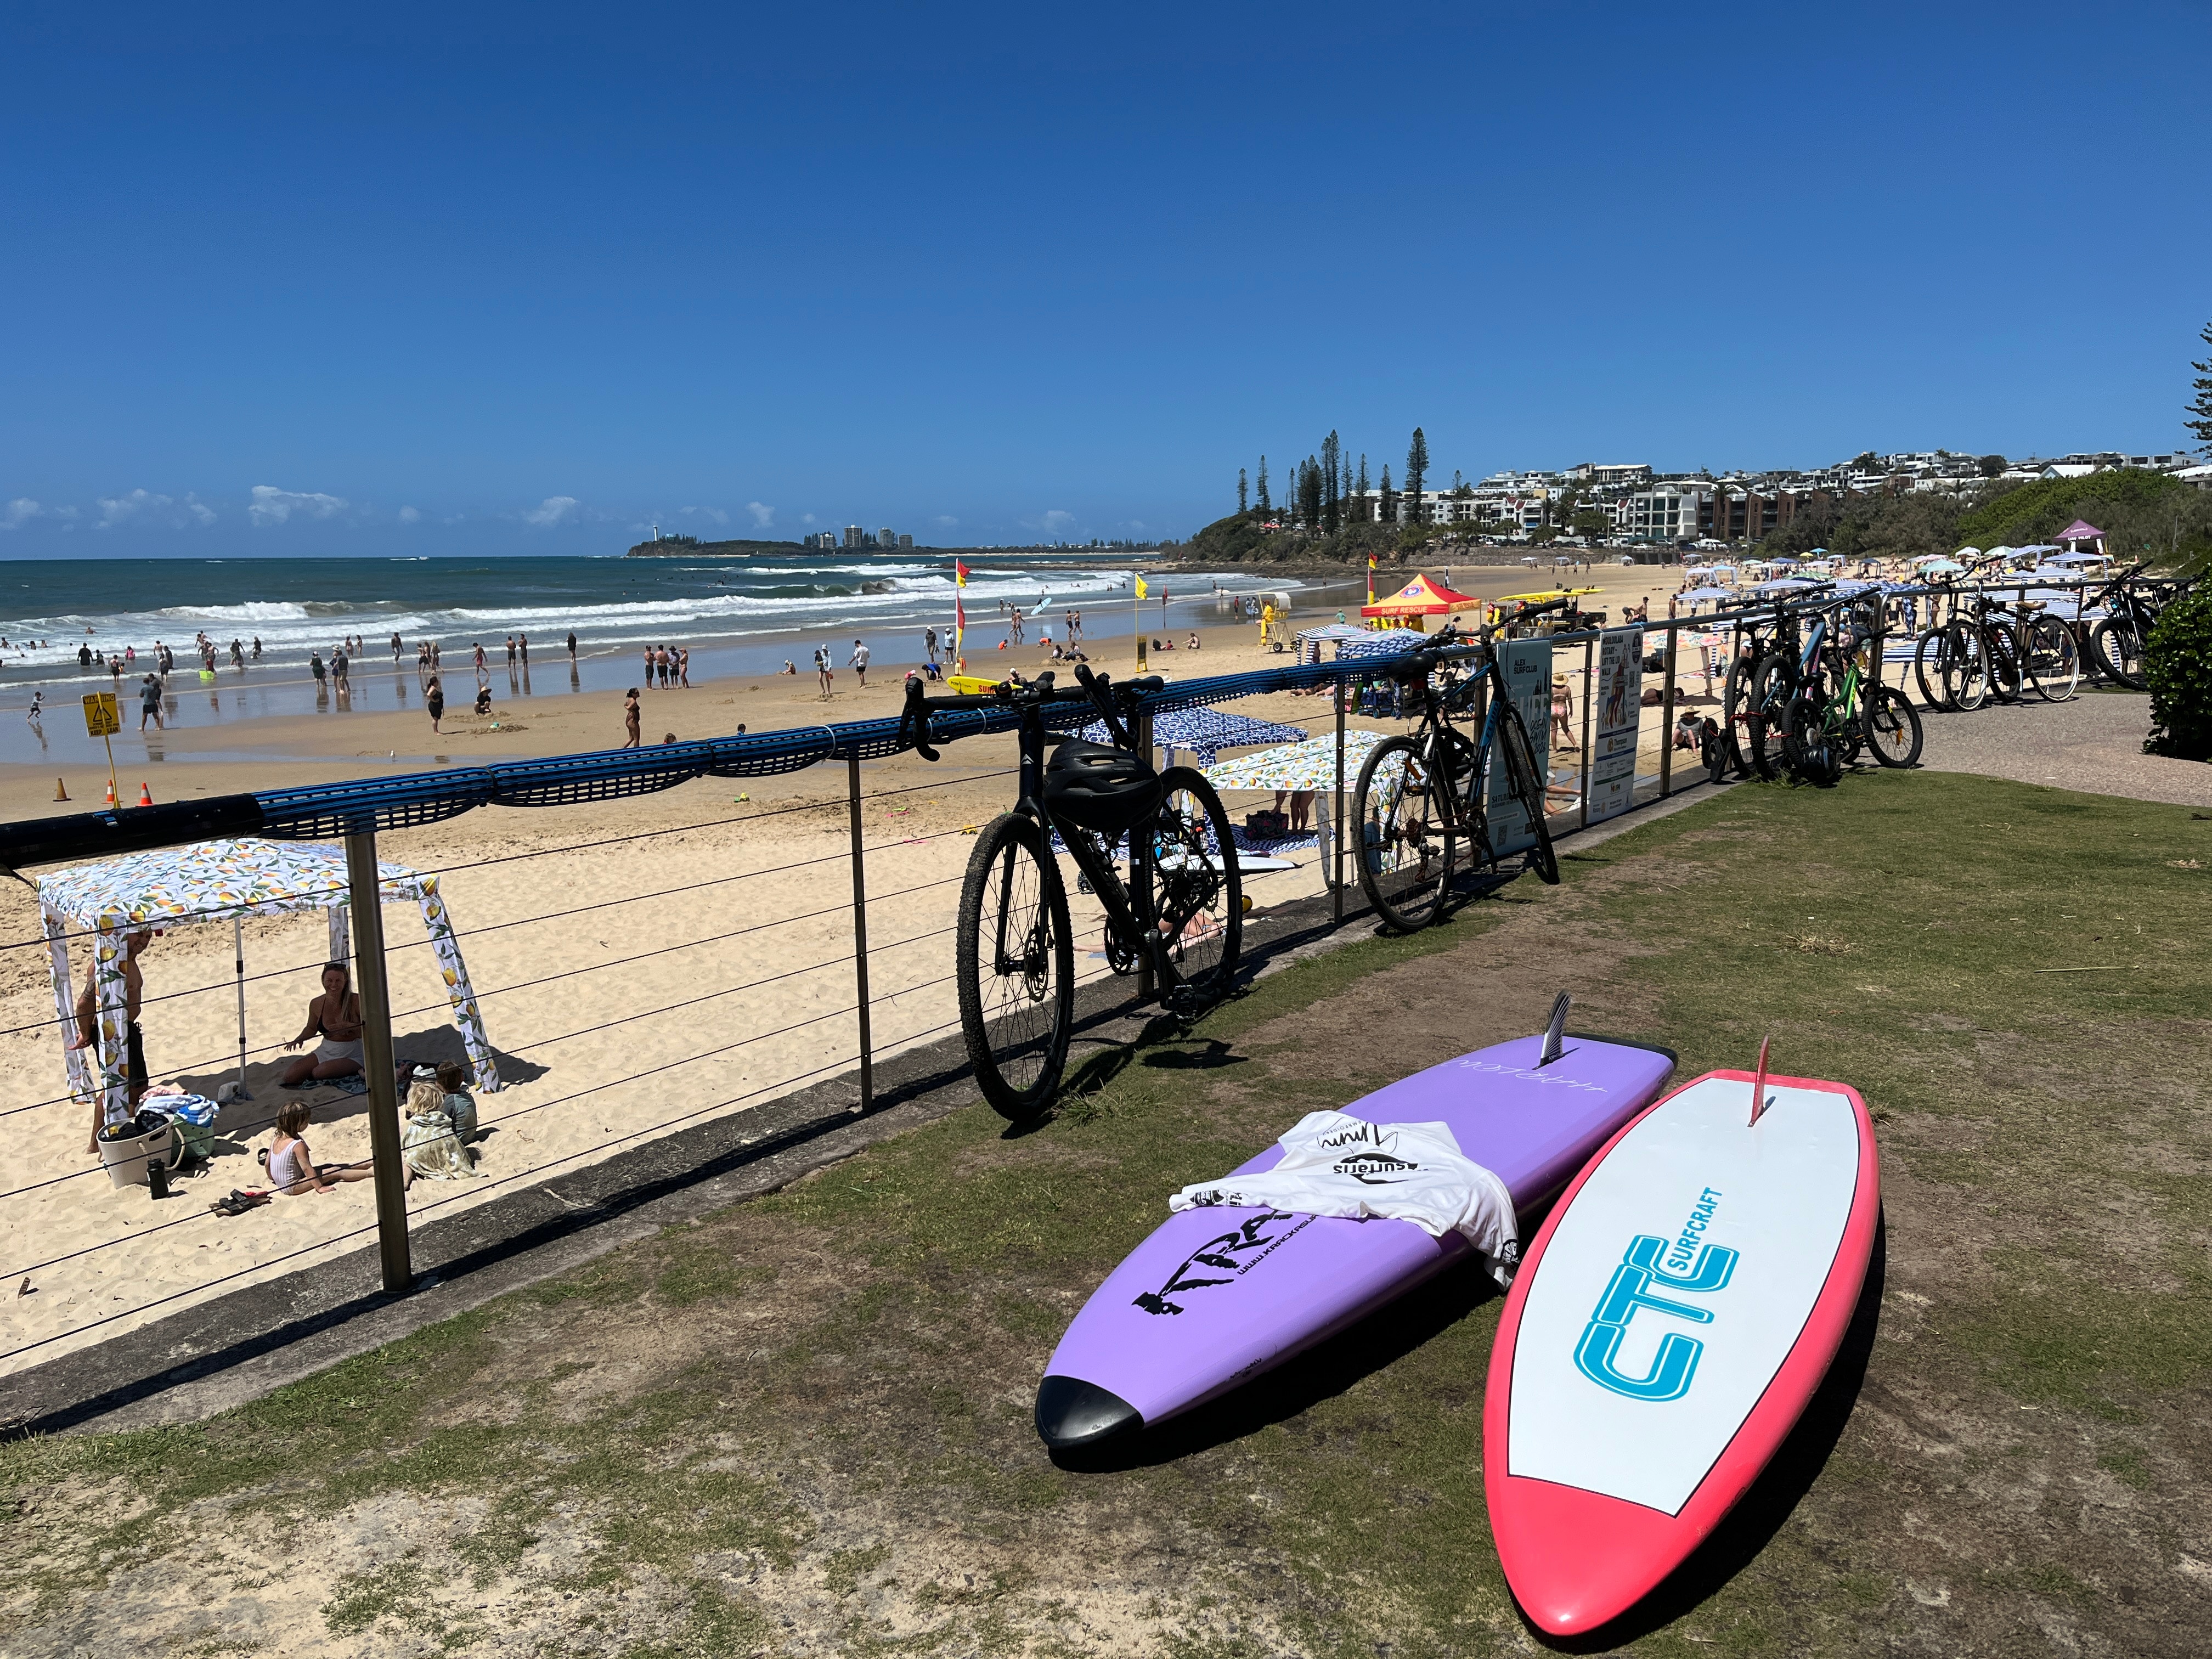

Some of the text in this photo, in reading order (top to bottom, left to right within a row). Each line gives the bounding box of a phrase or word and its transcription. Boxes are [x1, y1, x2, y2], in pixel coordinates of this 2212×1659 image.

[1530, 730, 1547, 742] SWIM
[1667, 1187, 1723, 1271] SURFCRAFT
[1573, 1235, 1740, 1402] CTC
